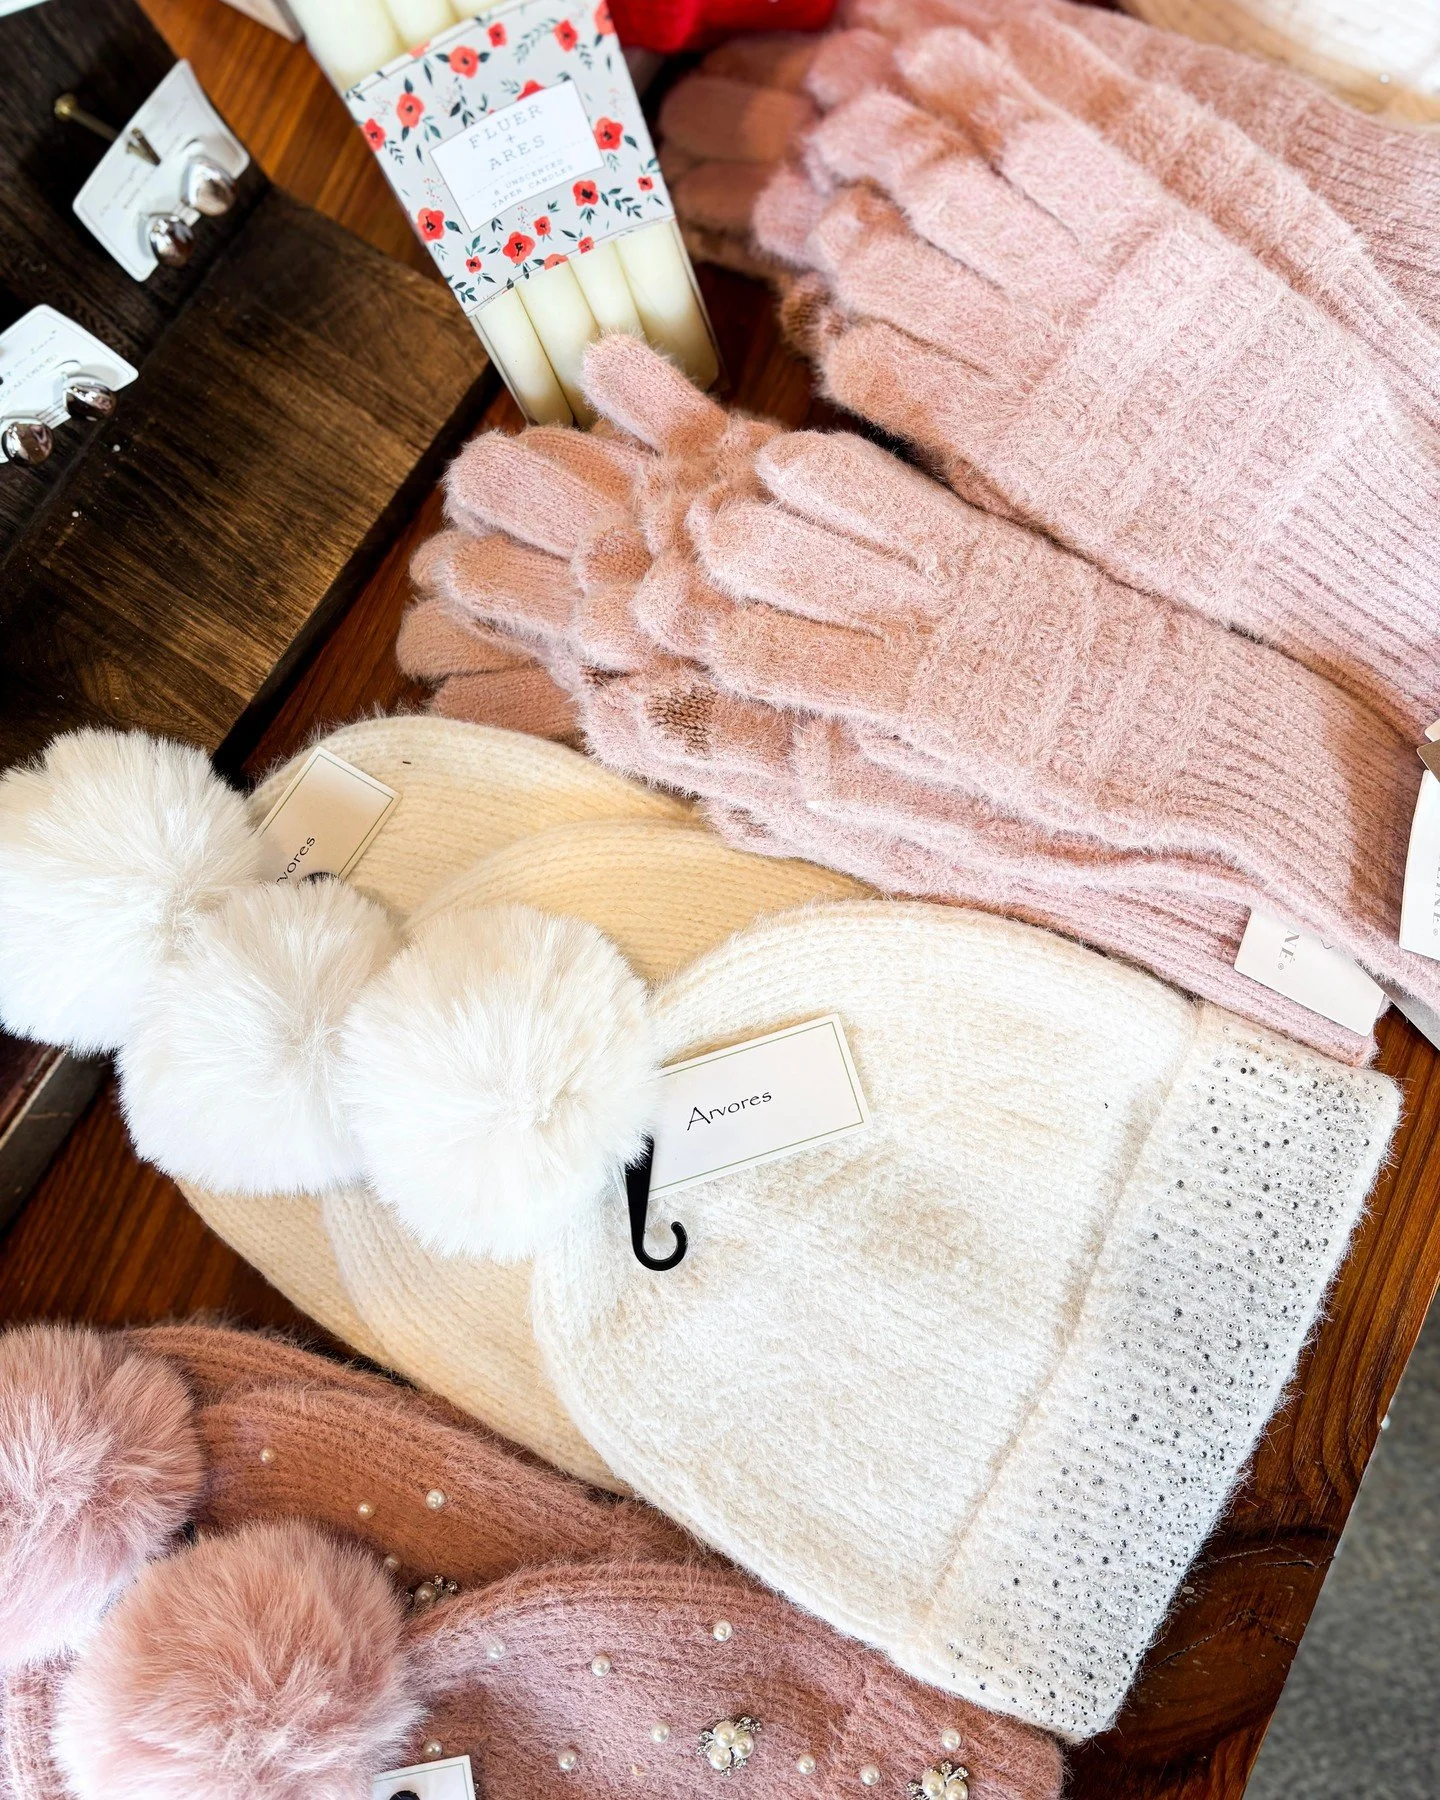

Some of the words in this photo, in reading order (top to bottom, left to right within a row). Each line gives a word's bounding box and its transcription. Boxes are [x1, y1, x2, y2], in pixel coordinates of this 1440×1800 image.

[469, 105, 544, 149] FLUER
[489, 134, 546, 171] ARES
[527, 164, 575, 190] CANDLES
[686, 1090, 773, 1131] Arvores
